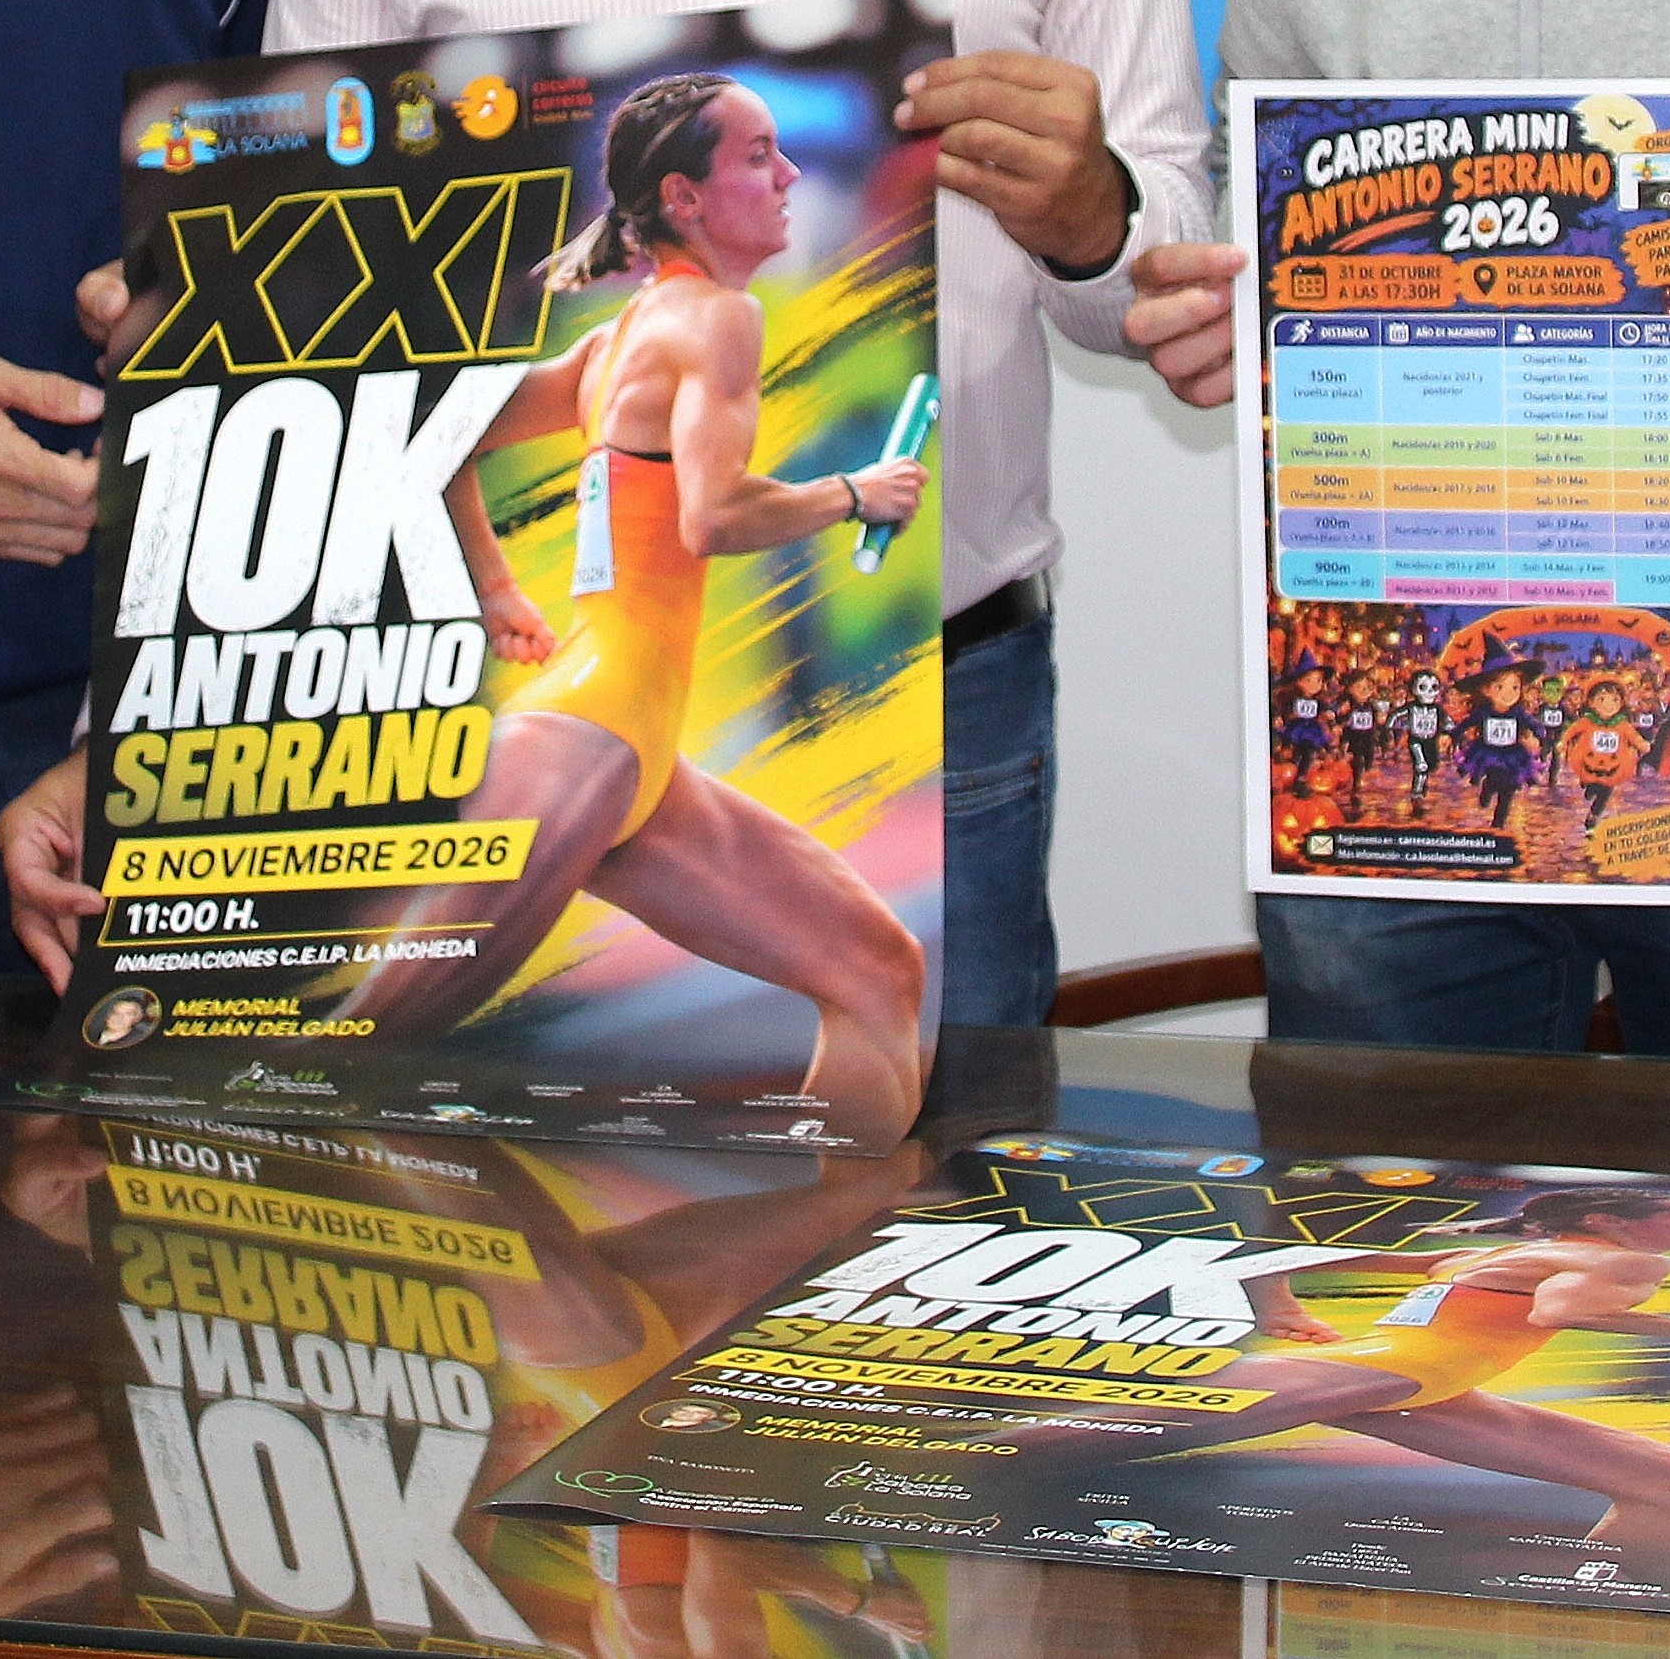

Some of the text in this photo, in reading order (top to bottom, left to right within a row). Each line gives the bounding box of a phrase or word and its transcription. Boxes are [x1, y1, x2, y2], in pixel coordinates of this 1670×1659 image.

[1305, 113, 1570, 188] CARRERA MINI
[1281, 152, 1613, 260] ANTONIO SERRANO
[1441, 195, 1560, 253] 2026
[119, 166, 572, 381] XXI
[1339, 265, 1442, 280] 31 DE OCTUBRE
[1506, 265, 1603, 279] PLAZA MAYOR
[1338, 285, 1442, 300] A LAS 17:30H
[1507, 283, 1607, 298] DE LA SOLANA
[1320, 326, 1371, 340] DISTANCIA
[1539, 326, 1594, 340] CATEGORÍAS
[1310, 370, 1348, 384] 150m
[1312, 430, 1349, 444] 300m
[1313, 473, 1350, 488] 500m
[113, 362, 530, 639] 10K
[1315, 561, 1352, 575] 900m
[109, 620, 488, 734] ANTONIO
[1492, 726, 1512, 738] 471
[103, 704, 494, 828] SERRANO
[122, 836, 512, 882] 8 NOVIEMBRE 2026
[125, 898, 259, 935] 11:00 H.
[115, 939, 478, 972] INMEDIACIONES C.E.I.P. LA MOHEDA
[171, 997, 302, 1018] MEMORIAL
[254, 1018, 377, 1038] DELGADO
[892, 1166, 1481, 1250] XXI
[803, 1221, 1375, 1323] 10K
[763, 1289, 1258, 1348] ANTONIO
[728, 1316, 1243, 1379] SERRANO
[714, 1368, 887, 1400] 11:00 H.
[725, 1350, 1236, 1407] 8 NOVIEMBRE 2026
[686, 1382, 1166, 1436] INMEDIACIONES C.E.I.P. LA MOHEDA
[755, 1413, 923, 1439] MEMORIAL
[868, 1435, 1020, 1457] DELGADO
